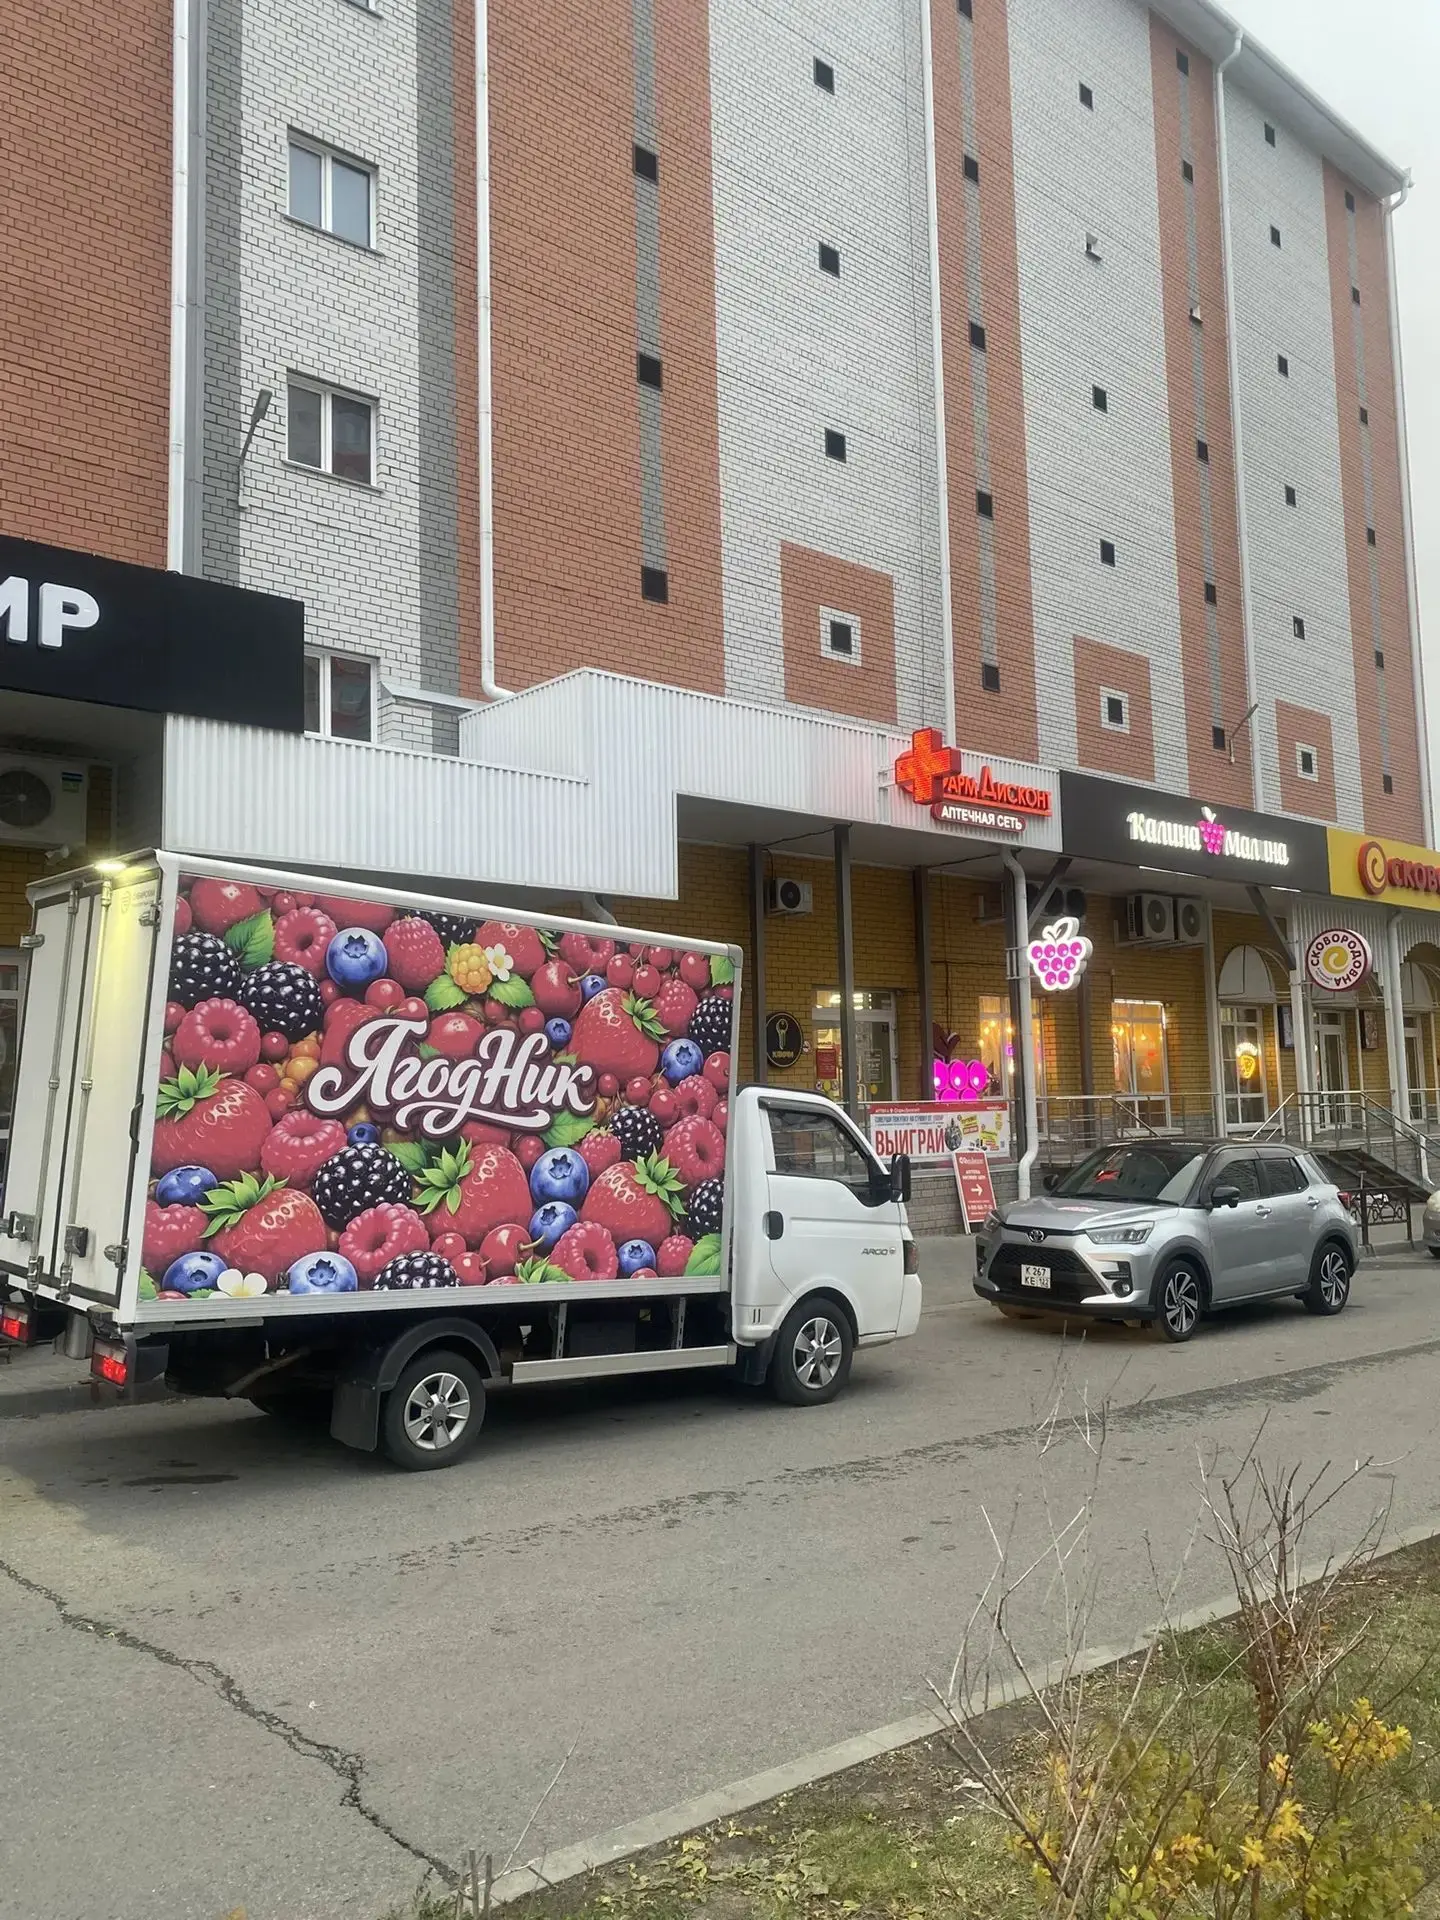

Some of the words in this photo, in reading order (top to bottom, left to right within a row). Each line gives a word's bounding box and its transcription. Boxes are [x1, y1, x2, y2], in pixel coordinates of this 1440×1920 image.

[941, 806, 995, 825] АПТЕЧНАЯ
[997, 815, 1022, 830] СЕТЬ
[1126, 812, 1201, 851] Калина
[1224, 830, 1289, 866] Малина
[1311, 934, 1362, 986] СКОВОРОДОВНА
[875, 1125, 945, 1156] ВЫИГРАЙ
